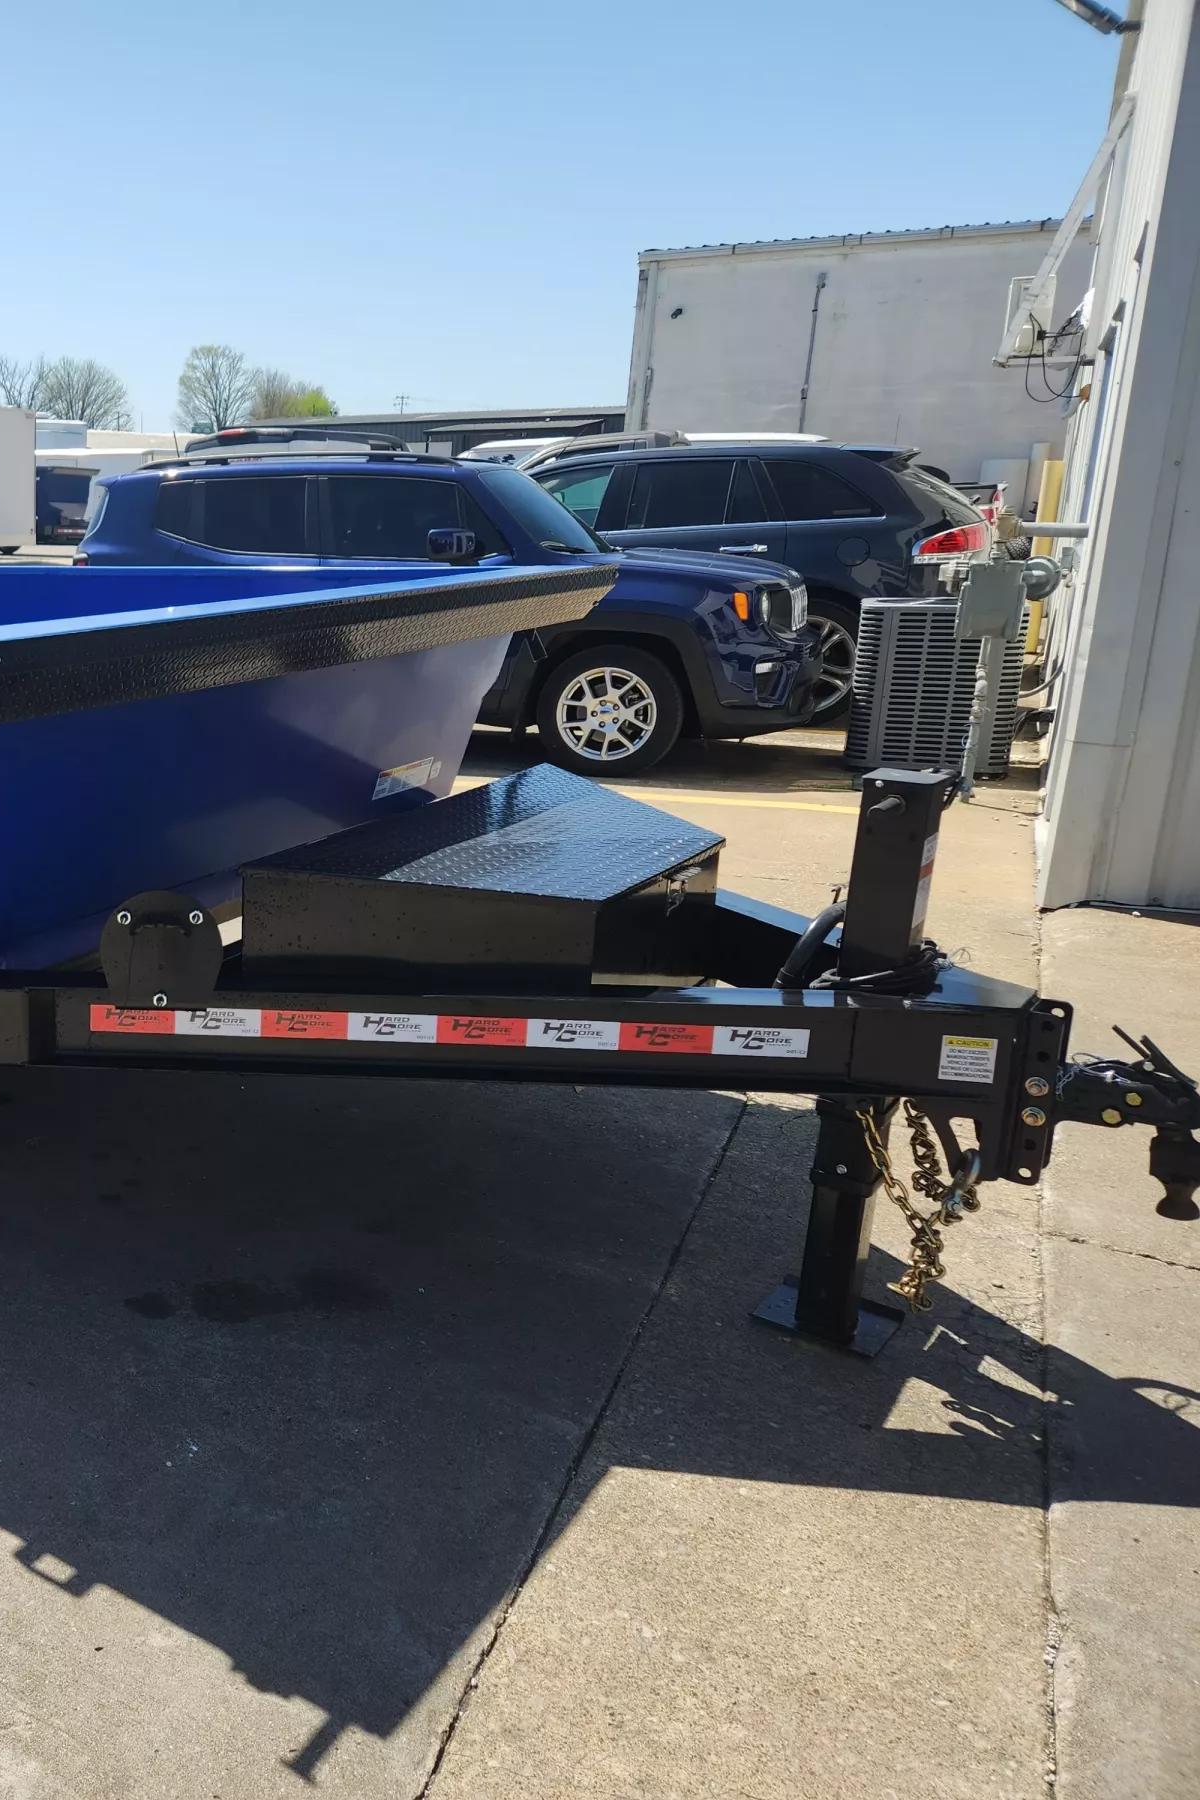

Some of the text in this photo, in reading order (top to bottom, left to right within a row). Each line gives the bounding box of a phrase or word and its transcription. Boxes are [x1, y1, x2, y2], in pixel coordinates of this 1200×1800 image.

[201, 1018, 246, 1030] CORE
[362, 1016, 411, 1028] HARD
[451, 1018, 500, 1031] HARD
[542, 1022, 592, 1035] HARD
[374, 1024, 422, 1036] CORE
[464, 1026, 512, 1039] CORE
[555, 1029, 604, 1043] CORE
[635, 1025, 686, 1038] HARD
[729, 1029, 781, 1042] HARD
[647, 1034, 699, 1047] CORE
[741, 1037, 793, 1050] CORE
